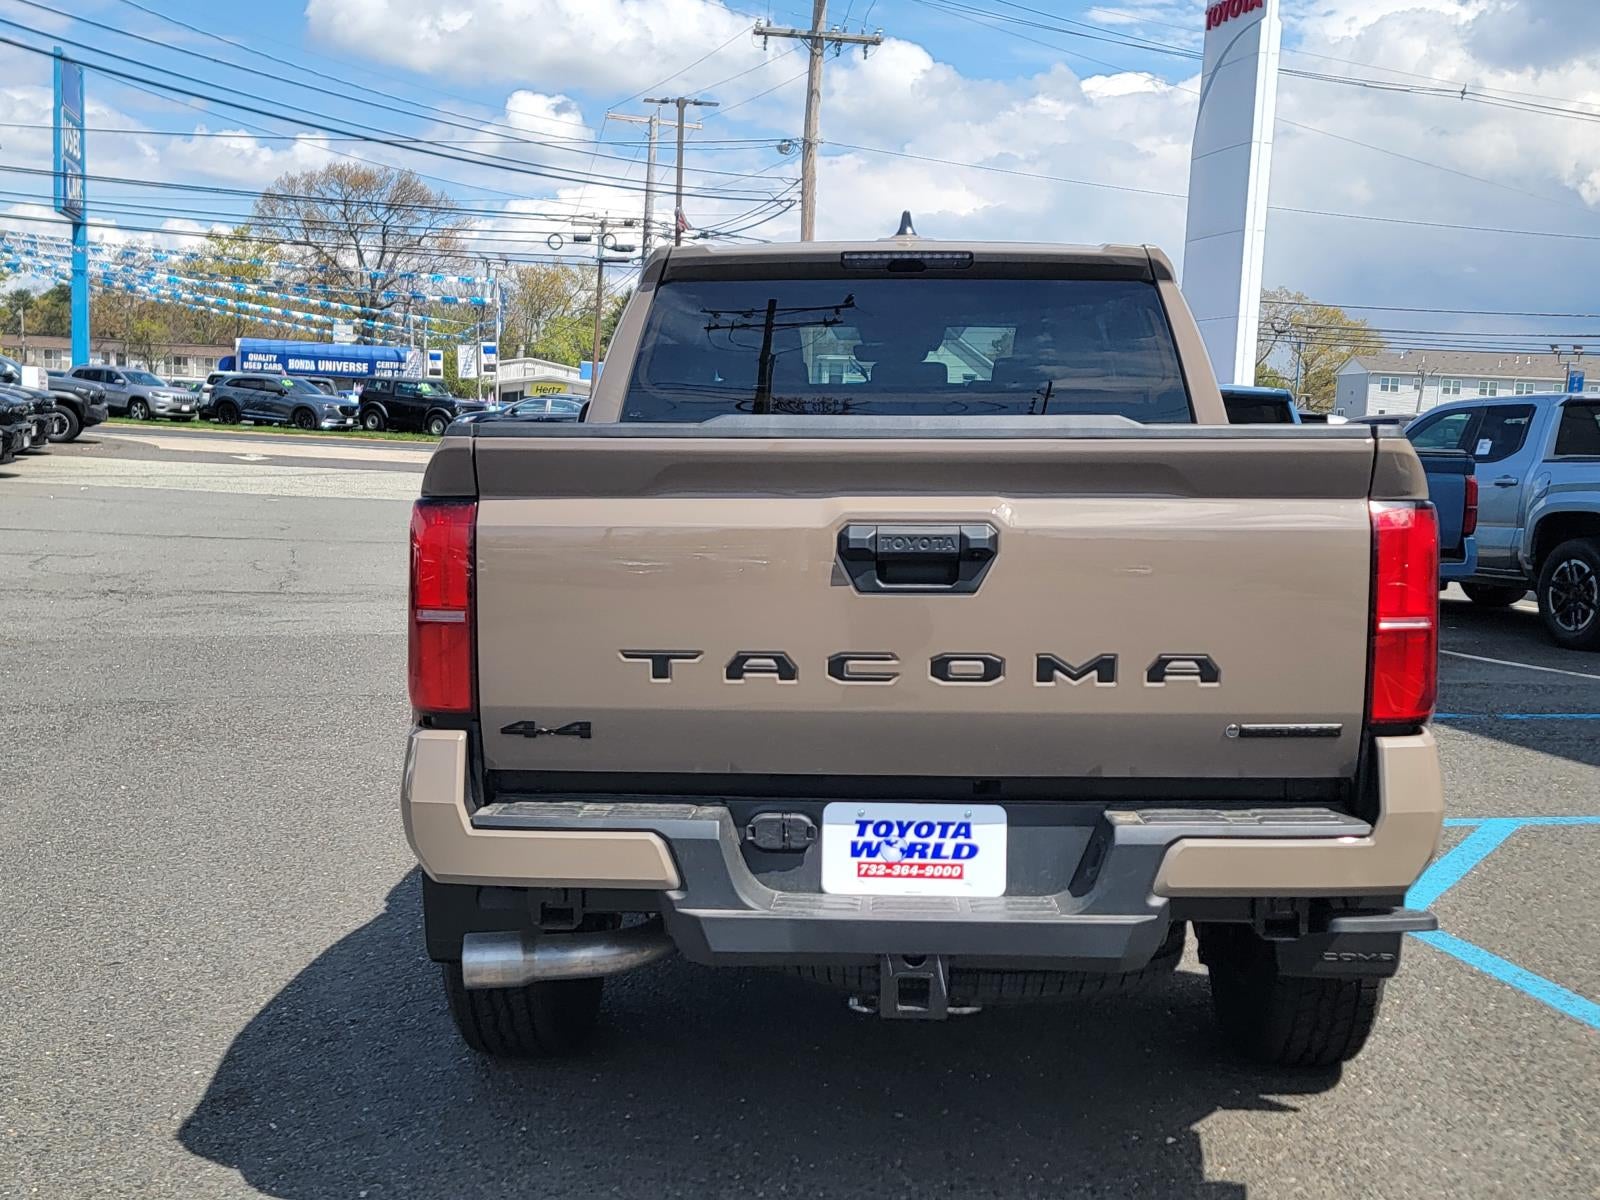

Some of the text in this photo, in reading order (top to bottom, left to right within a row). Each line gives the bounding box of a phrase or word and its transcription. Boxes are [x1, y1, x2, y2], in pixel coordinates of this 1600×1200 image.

[64, 119, 81, 160] USED
[248, 353, 277, 362] QUALITY
[243, 361, 283, 371] USED CARS
[288, 358, 369, 373] HONDA UNIVERSE
[535, 385, 562, 394] Hertz
[880, 536, 956, 550] TOYOTA
[617, 648, 1222, 688] TACOMA
[854, 819, 973, 840] TOYOTA
[858, 863, 962, 878] 732-364-9000
